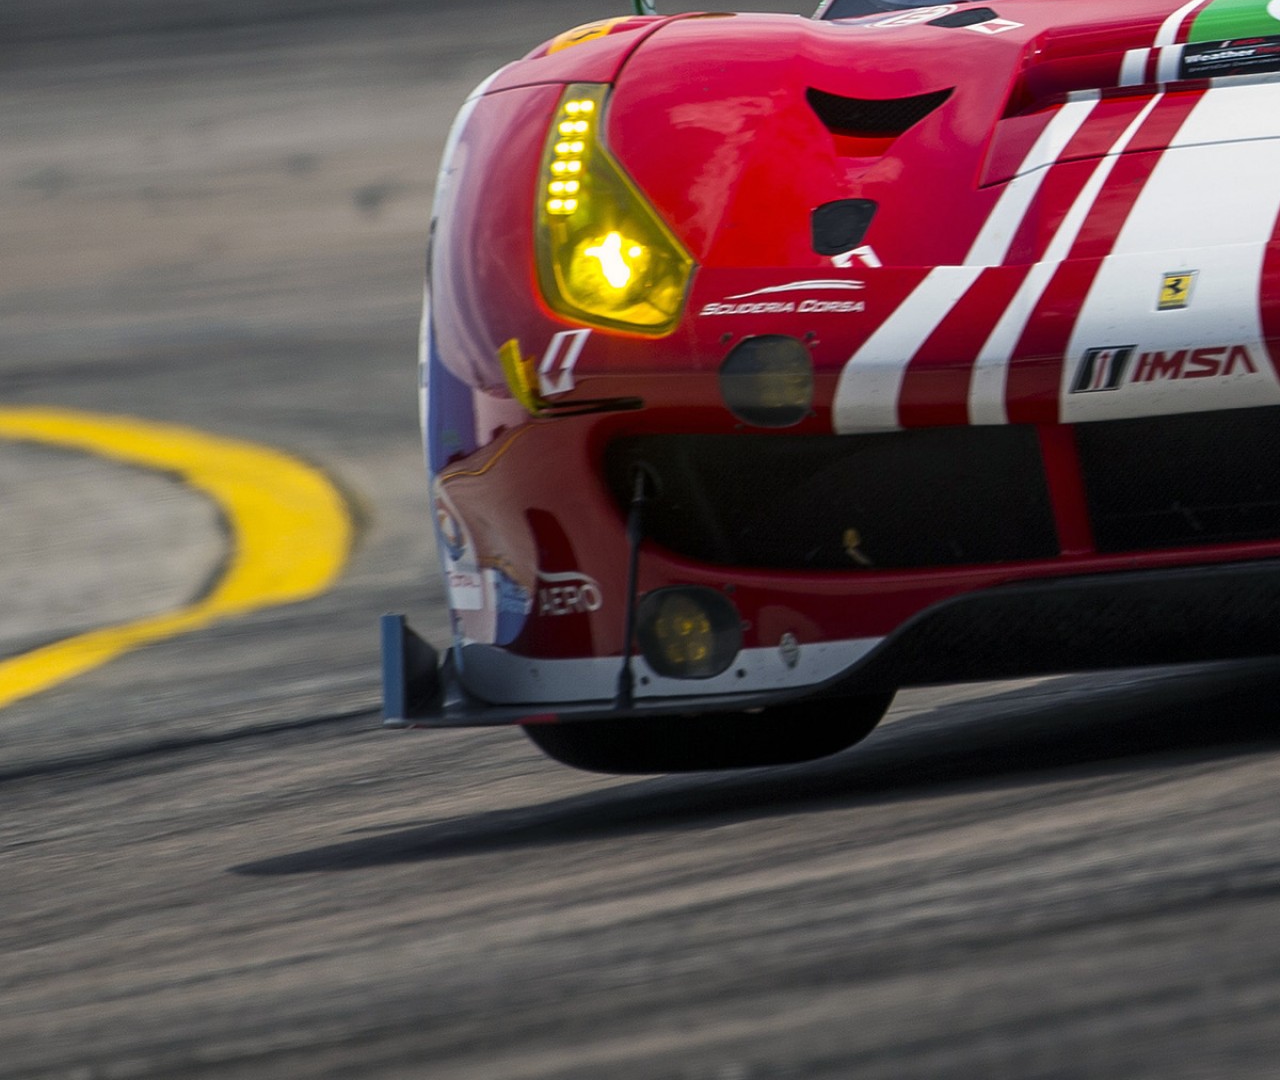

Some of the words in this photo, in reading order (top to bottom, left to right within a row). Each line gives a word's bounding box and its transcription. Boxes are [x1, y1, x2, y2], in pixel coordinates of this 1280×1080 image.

[699, 302, 796, 316] SCUDERIA
[796, 299, 866, 313] CORSA
[1131, 345, 1258, 383] IMSA
